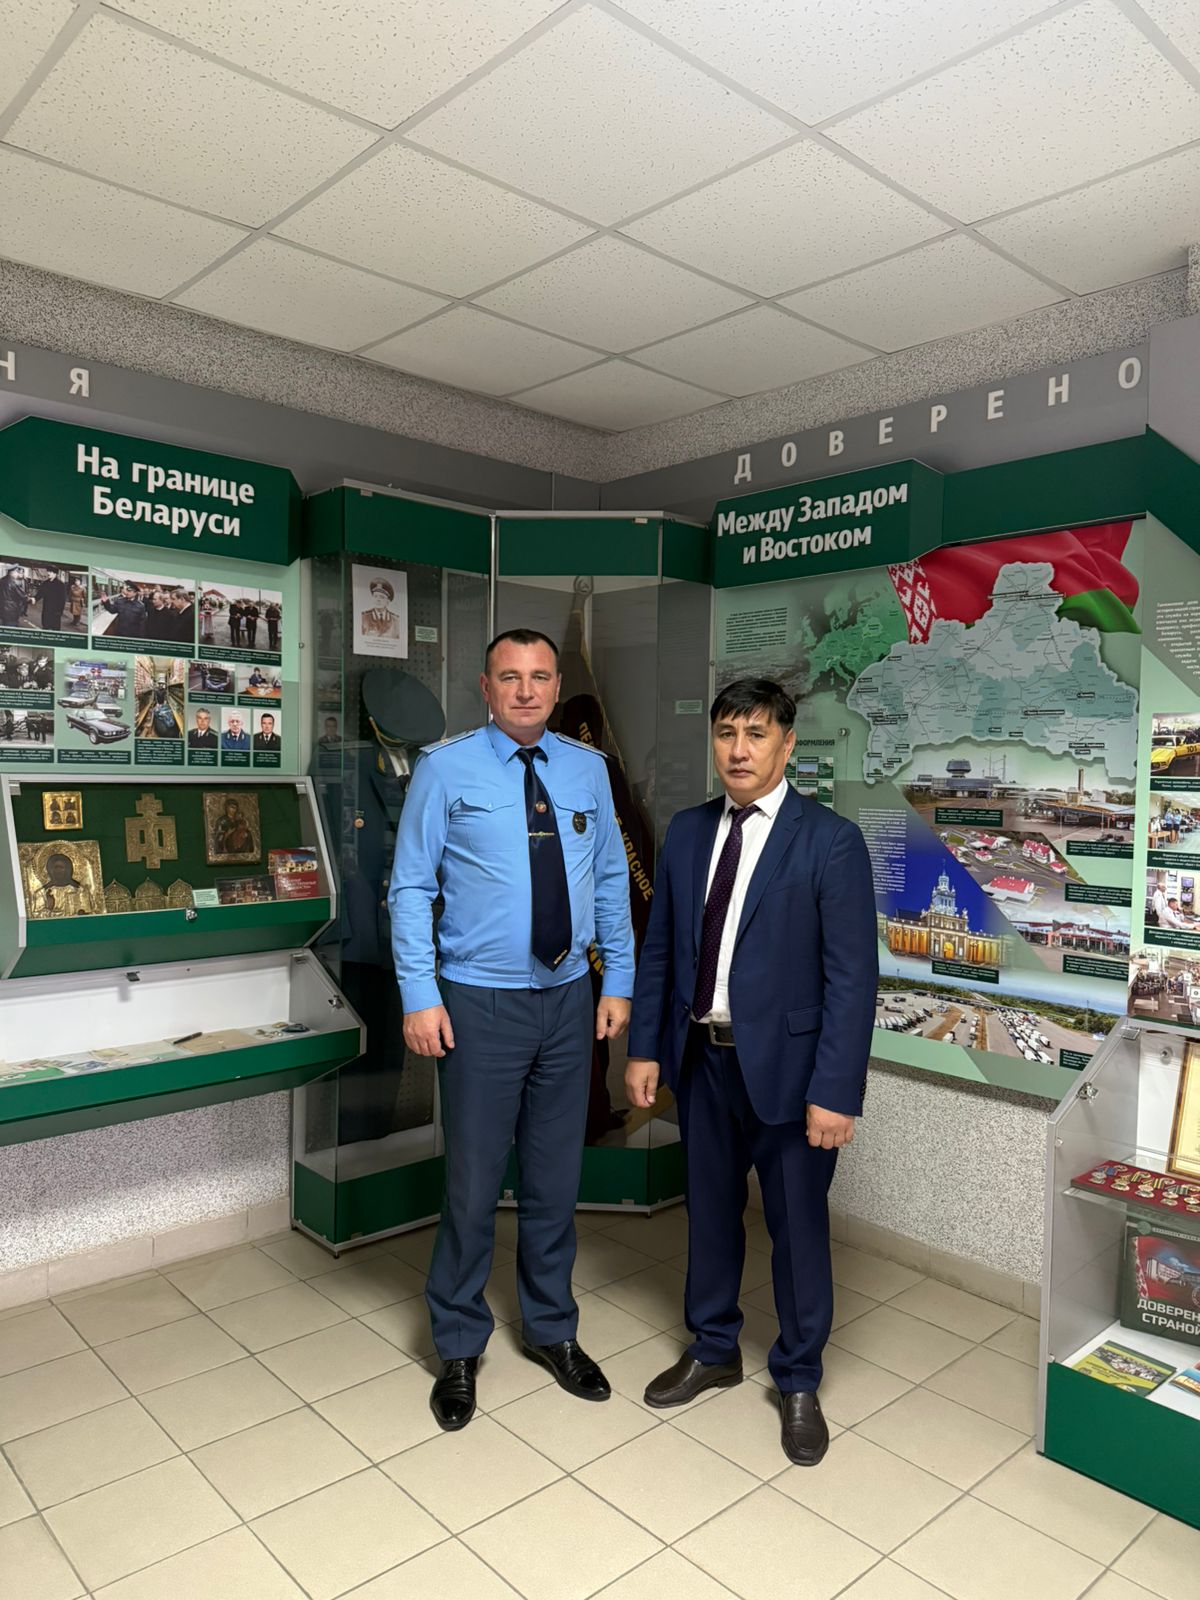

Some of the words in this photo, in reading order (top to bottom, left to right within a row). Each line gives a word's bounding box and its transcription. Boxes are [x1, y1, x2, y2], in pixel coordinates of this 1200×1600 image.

[733, 357, 1142, 484] ДОВЕРЕНО
[77, 443, 119, 480] На
[131, 462, 255, 505] границе
[93, 485, 240, 537] Беларуси
[717, 505, 795, 537] Между
[798, 483, 908, 524] Западом
[743, 546, 756, 564] и
[760, 523, 872, 562] Востоком
